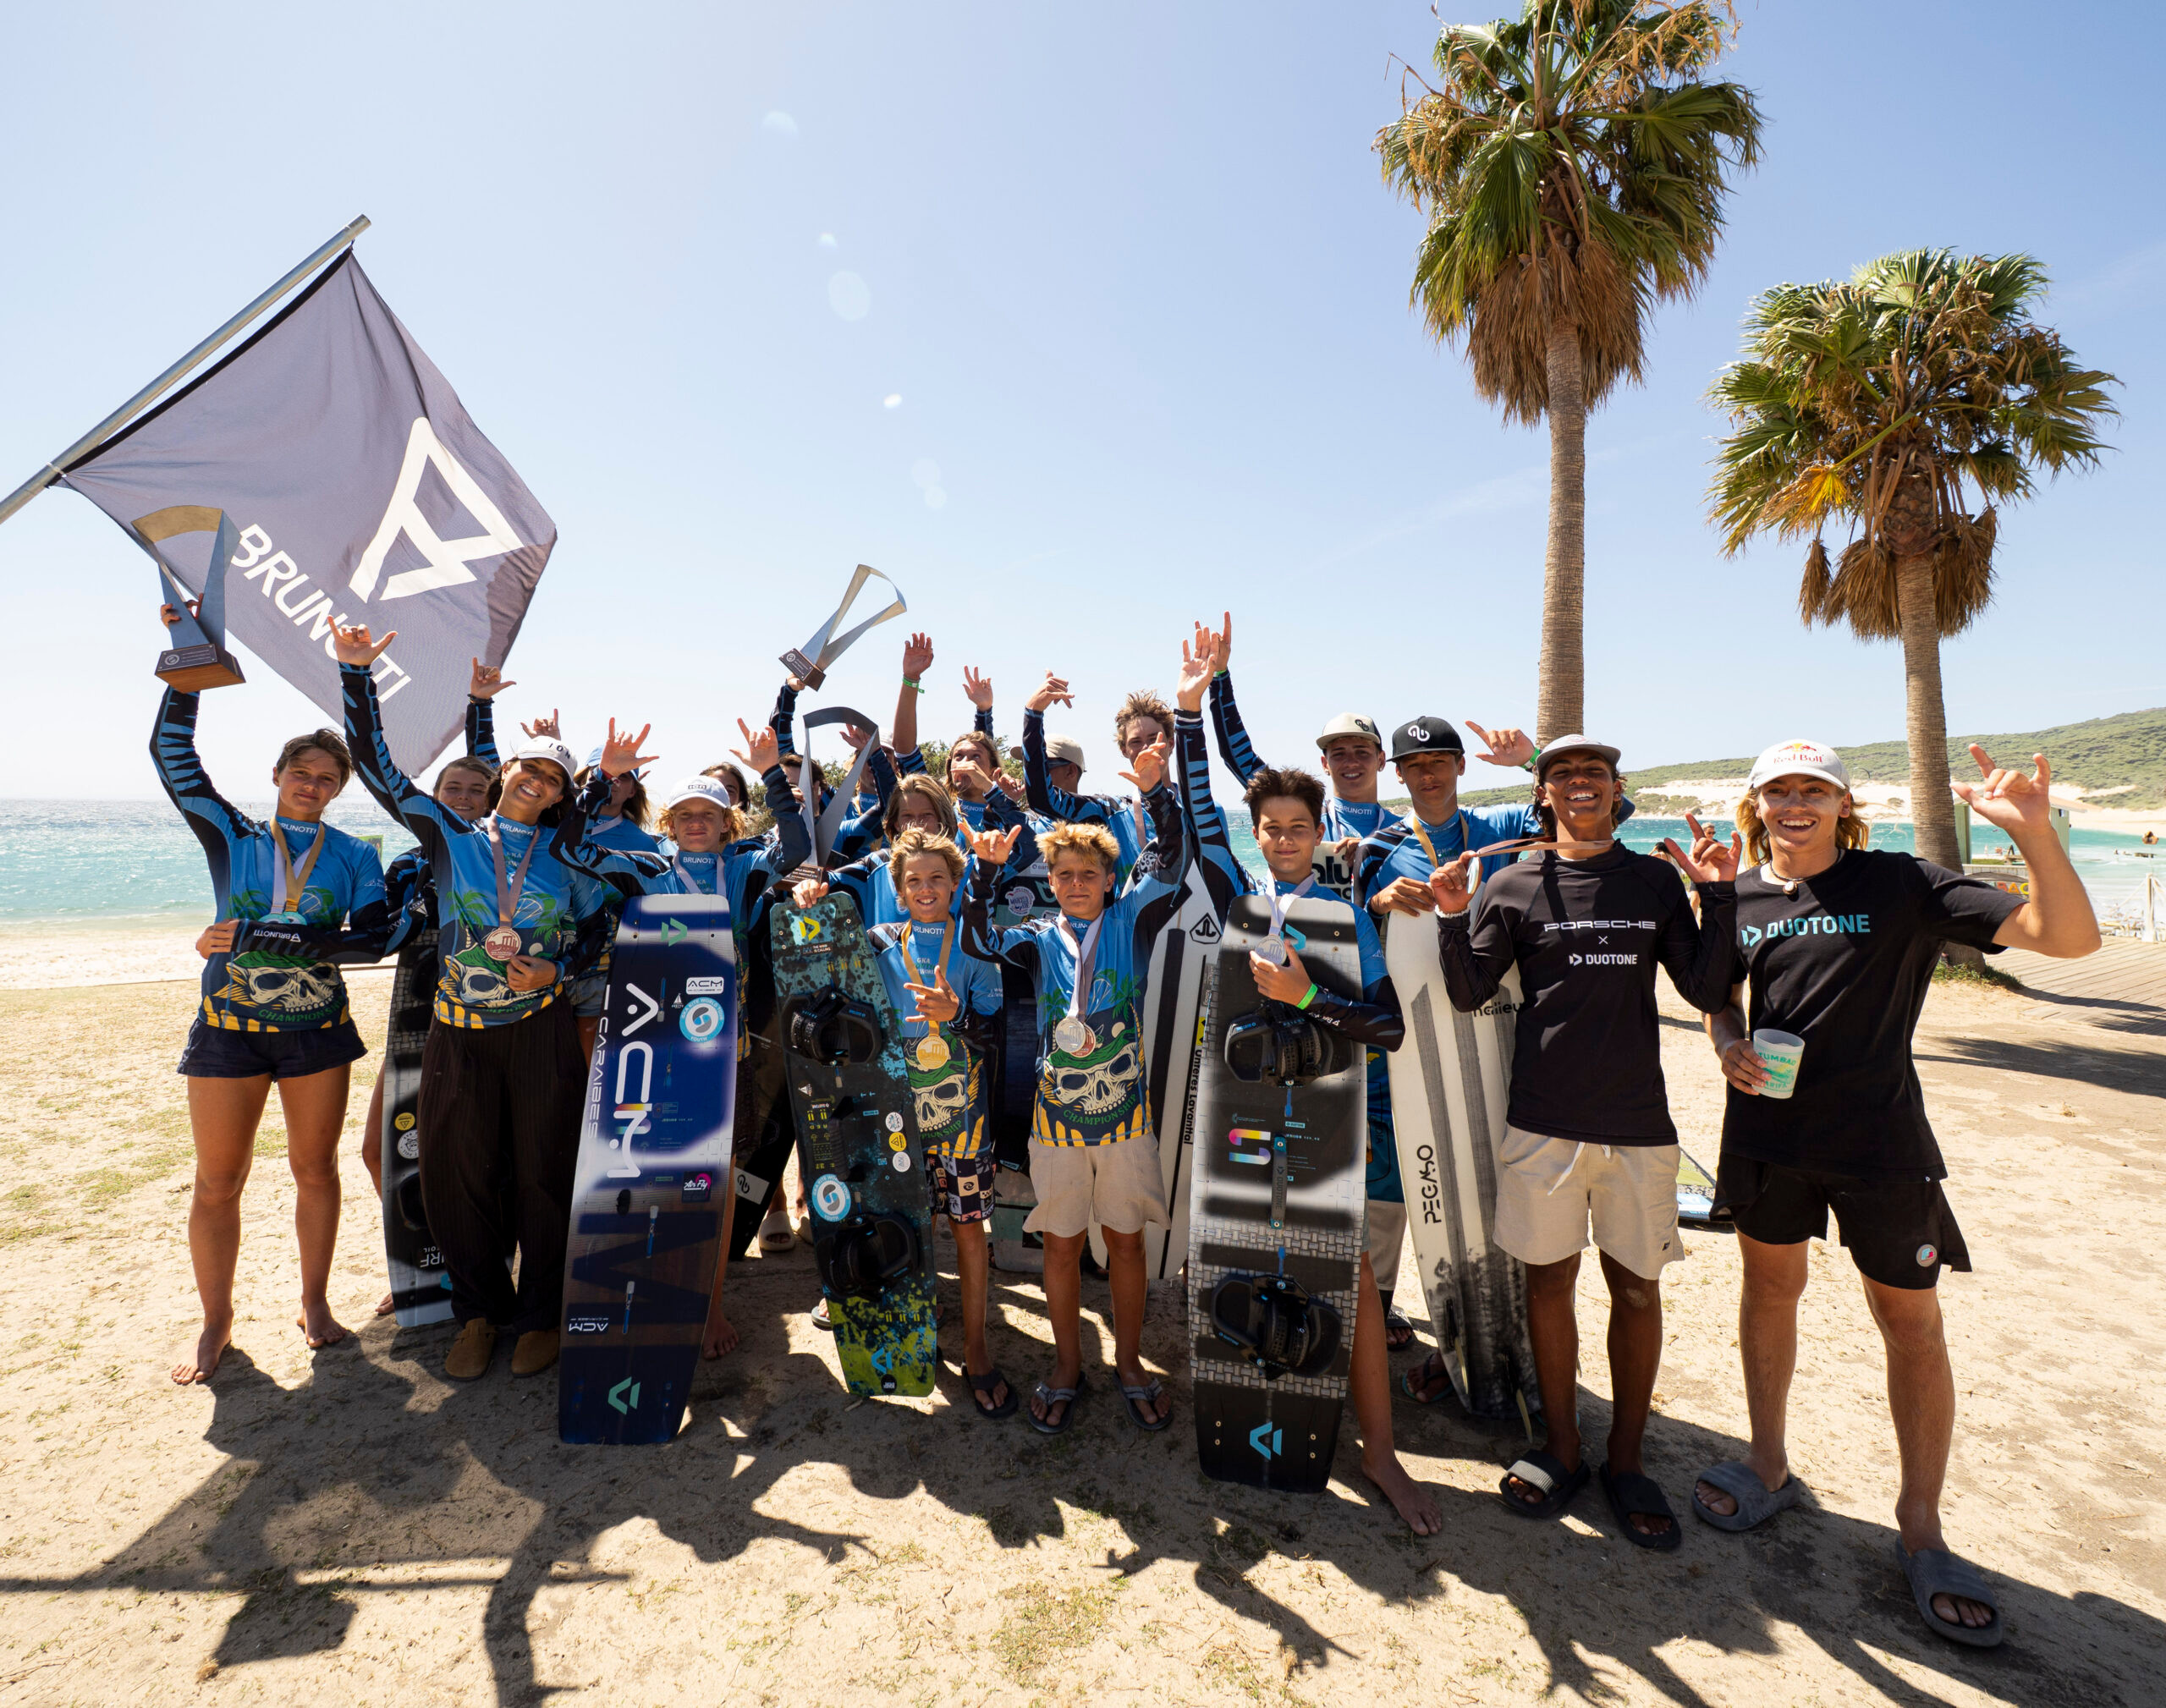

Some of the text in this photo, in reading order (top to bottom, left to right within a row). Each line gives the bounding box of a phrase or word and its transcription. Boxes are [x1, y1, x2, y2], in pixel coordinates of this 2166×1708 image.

[231, 524, 412, 704] BRUNTI
[549, 743, 572, 760] ION
[1800, 754, 1822, 763] Bull
[1339, 805, 1372, 816] BRUNOTTI
[1543, 920, 1656, 931] PORSCHE
[1766, 914, 1871, 940] DUOTONE
[254, 929, 293, 942] BRUNOTTI
[1586, 954, 1638, 964] DUOTONE
[588, 1016, 609, 1139] CARAIBES
[1416, 1145, 1442, 1225] PEGASO
[569, 1322, 608, 1332] ACM
